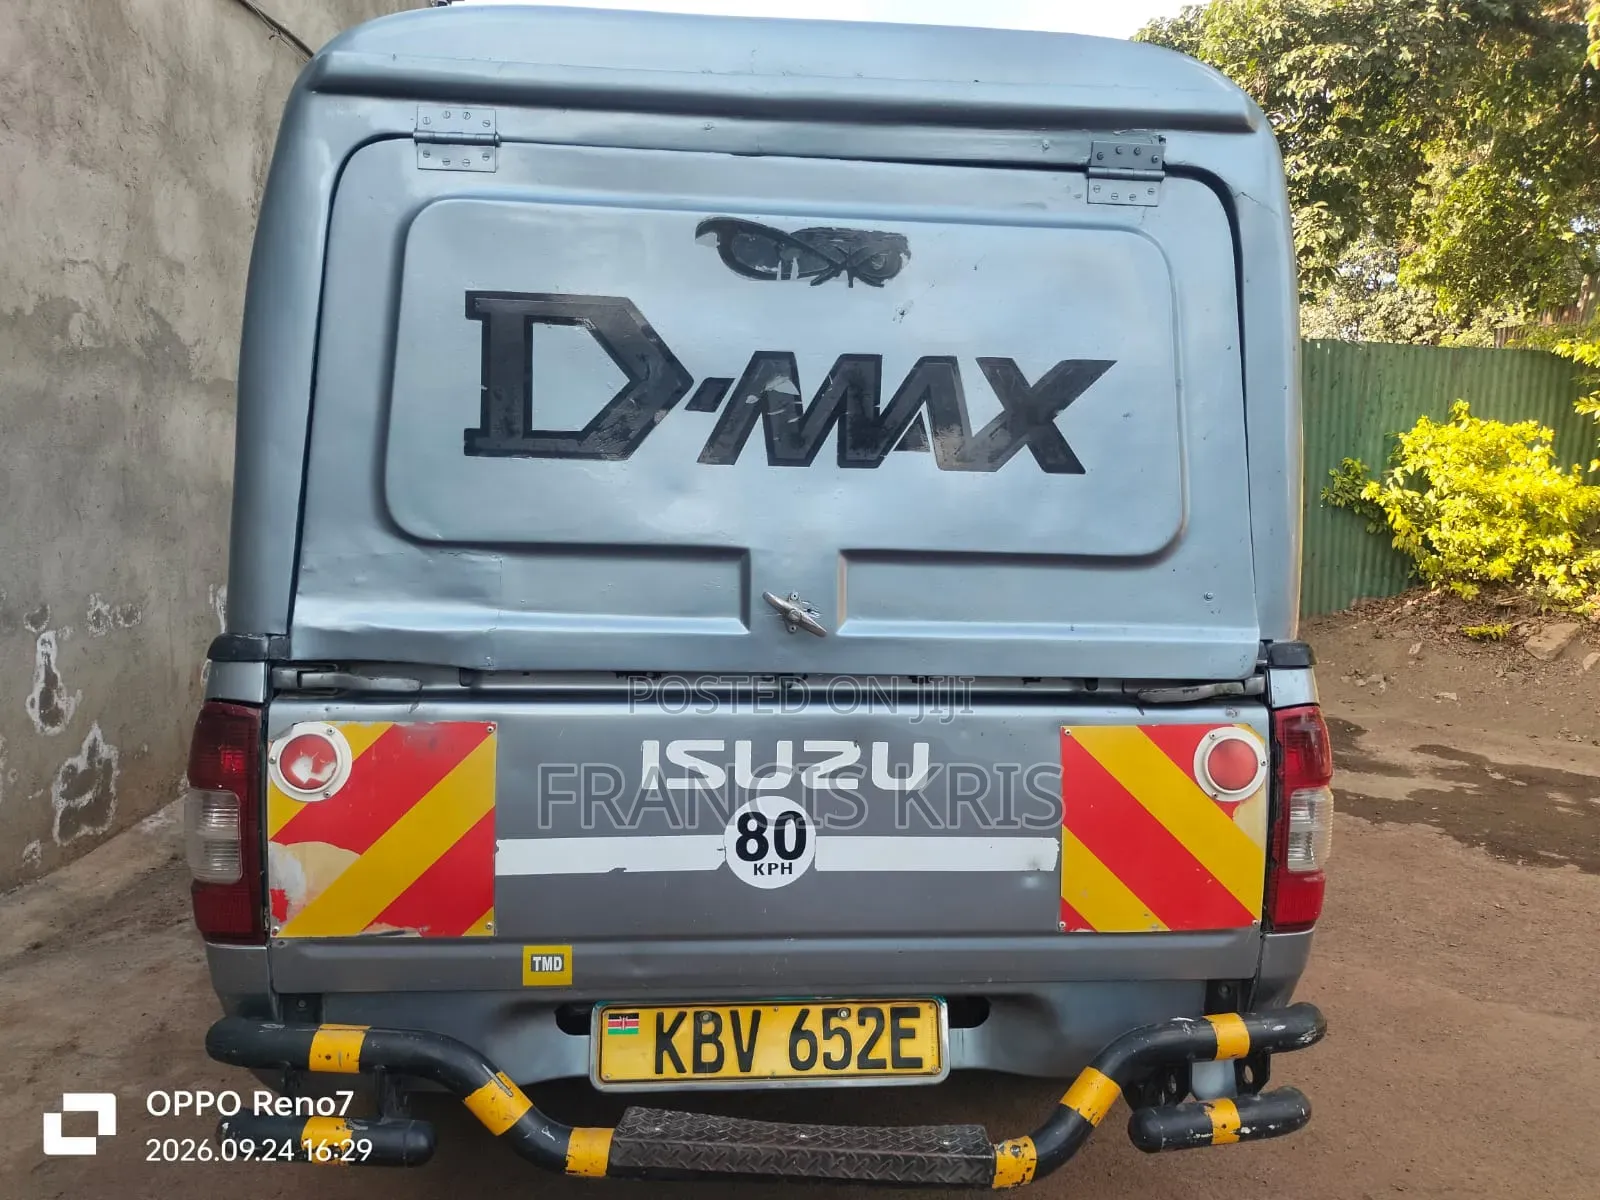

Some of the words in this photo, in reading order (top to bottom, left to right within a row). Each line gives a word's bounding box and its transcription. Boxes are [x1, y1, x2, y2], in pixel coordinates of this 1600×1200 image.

[464, 290, 1118, 475] D-MAX
[641, 740, 930, 790] ISUZU
[734, 810, 807, 862] 80
[753, 861, 793, 876] KPH
[532, 955, 563, 972] TMD
[654, 1008, 761, 1074] KBV
[788, 1006, 924, 1072] 652E
